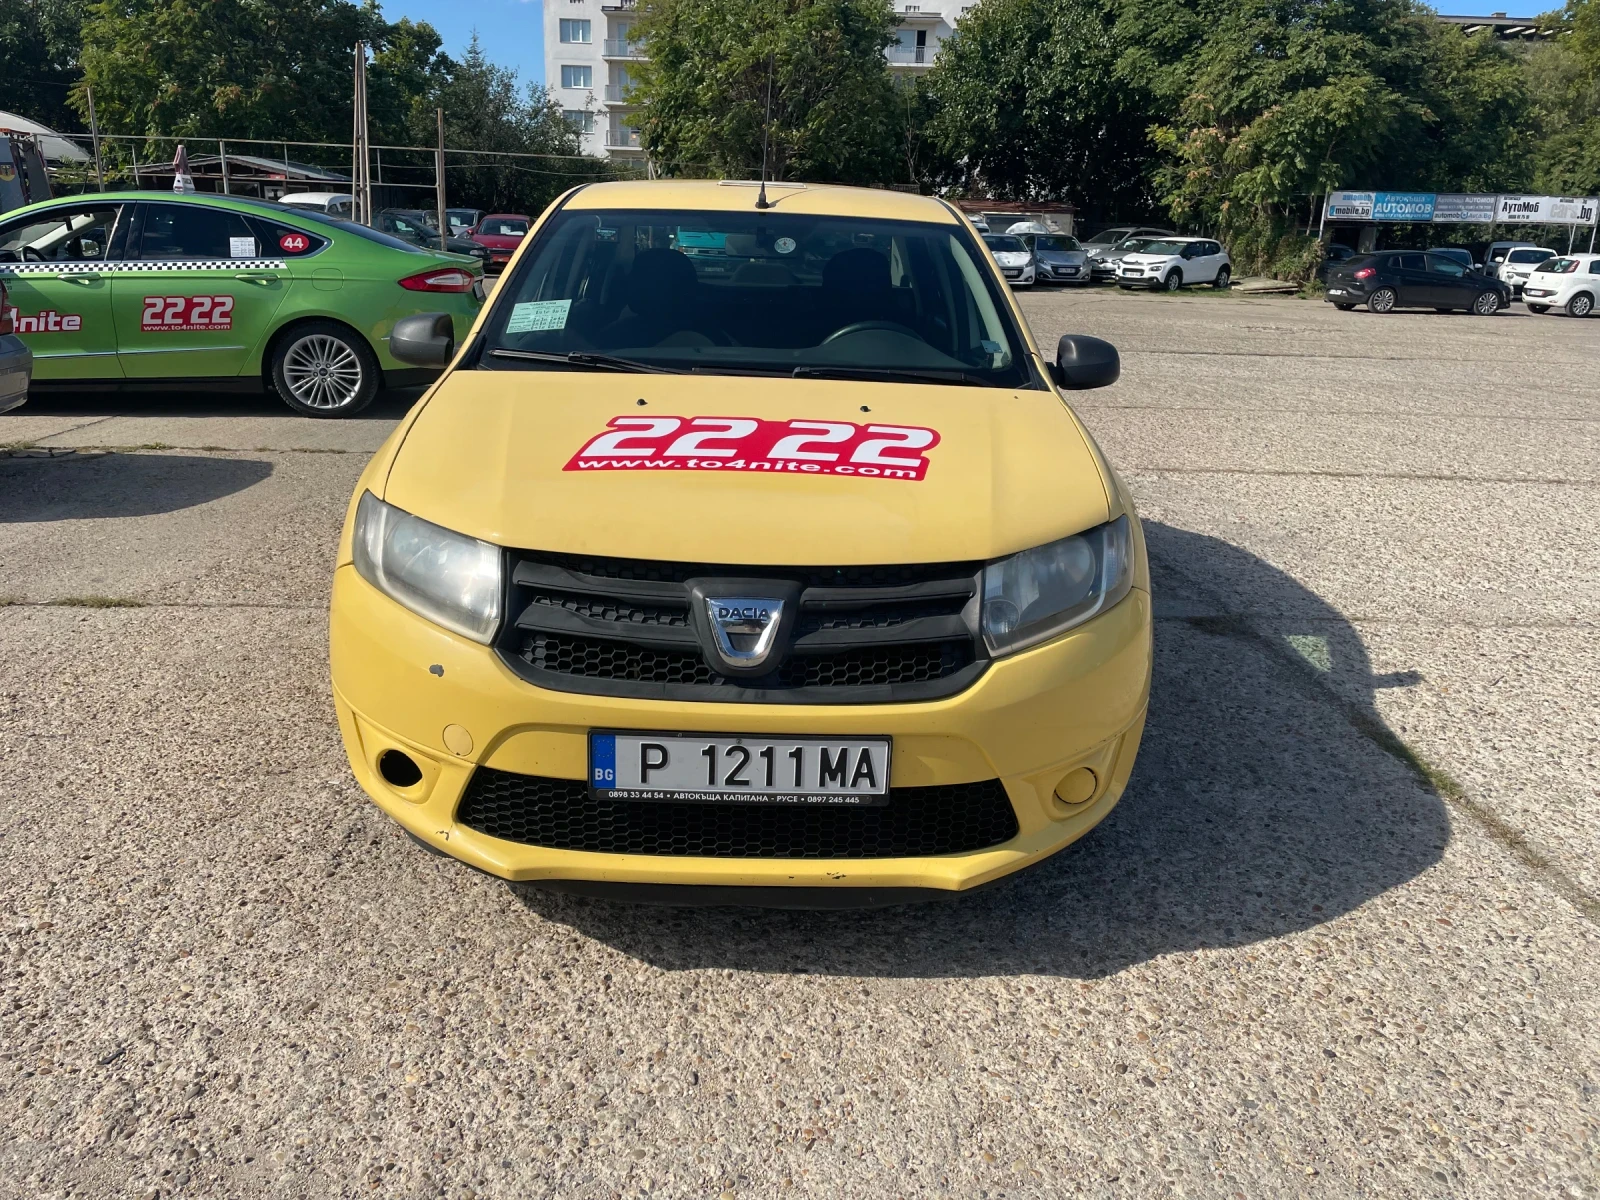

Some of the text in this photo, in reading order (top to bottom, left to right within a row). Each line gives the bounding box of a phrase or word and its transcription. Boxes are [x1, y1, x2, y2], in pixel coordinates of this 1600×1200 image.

[1335, 206, 1370, 216] mobile.bg
[1374, 203, 1432, 213] AUTOMOB
[1502, 202, 1540, 214] АутоМоб
[283, 237, 304, 249] 44
[143, 296, 233, 325] 22 22
[580, 418, 934, 468] 22 22
[578, 458, 916, 478] www.to4nite.com
[718, 607, 770, 619] DACIA
[594, 768, 614, 780] BG
[608, 790, 629, 798] 0898
[641, 791, 652, 799] 44
[673, 792, 721, 801] АВТОКЪЩА
[723, 794, 769, 802] КАПИТАНА
